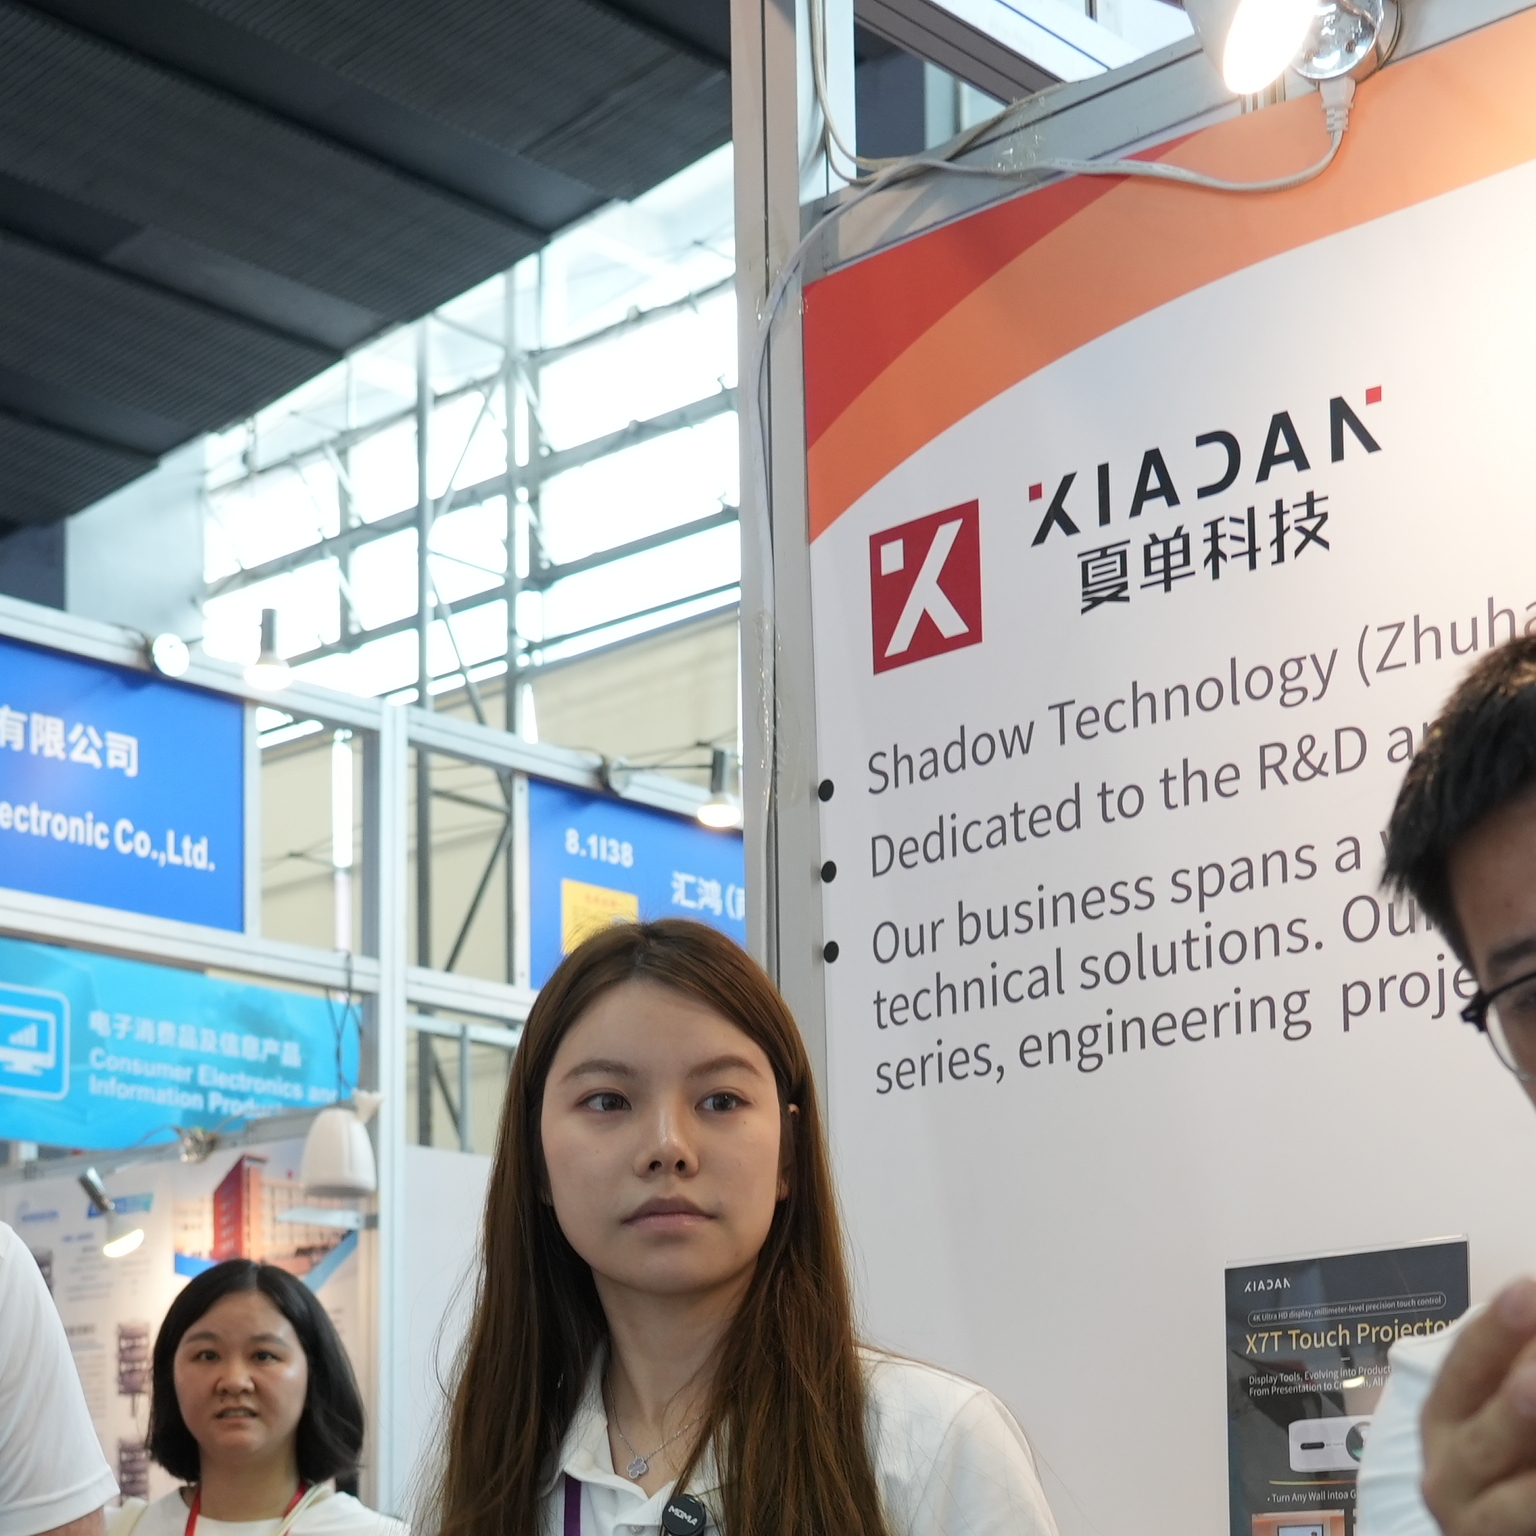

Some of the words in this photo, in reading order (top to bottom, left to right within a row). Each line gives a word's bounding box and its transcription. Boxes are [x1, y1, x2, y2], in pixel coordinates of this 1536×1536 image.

[1077, 489, 1331, 616] 夏单科技
[868, 716, 1035, 796] Shadow
[1047, 644, 1339, 744] Technology
[870, 784, 1082, 877] Dedicated
[1098, 777, 1144, 825] to
[1160, 759, 1241, 811] the
[1259, 726, 1368, 791] R&D
[114, 817, 216, 873] Co.,Ltd.
[871, 916, 945, 964] Our
[956, 870, 1155, 950] business
[1170, 835, 1317, 902] spans
[1335, 836, 1361, 872] a
[873, 948, 1064, 1031] technical
[1079, 910, 1325, 991] solutions.
[875, 1043, 1006, 1094] series,
[1019, 978, 1311, 1074] engineering
[89, 1074, 204, 1111] Information
[90, 1047, 193, 1083] Consumer
[198, 1064, 303, 1100] Electronics
[1365, 1301, 1396, 1313] precision
[1396, 1299, 1416, 1309] touch
[1417, 1296, 1442, 1306] control
[1245, 1330, 1282, 1354] X7T
[1288, 1324, 1350, 1350] Touch
[1249, 1374, 1278, 1386] Display
[1280, 1371, 1303, 1384] Tools,
[1305, 1367, 1339, 1381] Evolving
[1340, 1366, 1356, 1378] into
[1249, 1385, 1269, 1397] From
[1271, 1382, 1322, 1396] Presentation
[1323, 1381, 1332, 1391] to
[1273, 1494, 1290, 1503] Turn
[1292, 1492, 1306, 1504] Any
[1308, 1490, 1325, 1500] Wall
